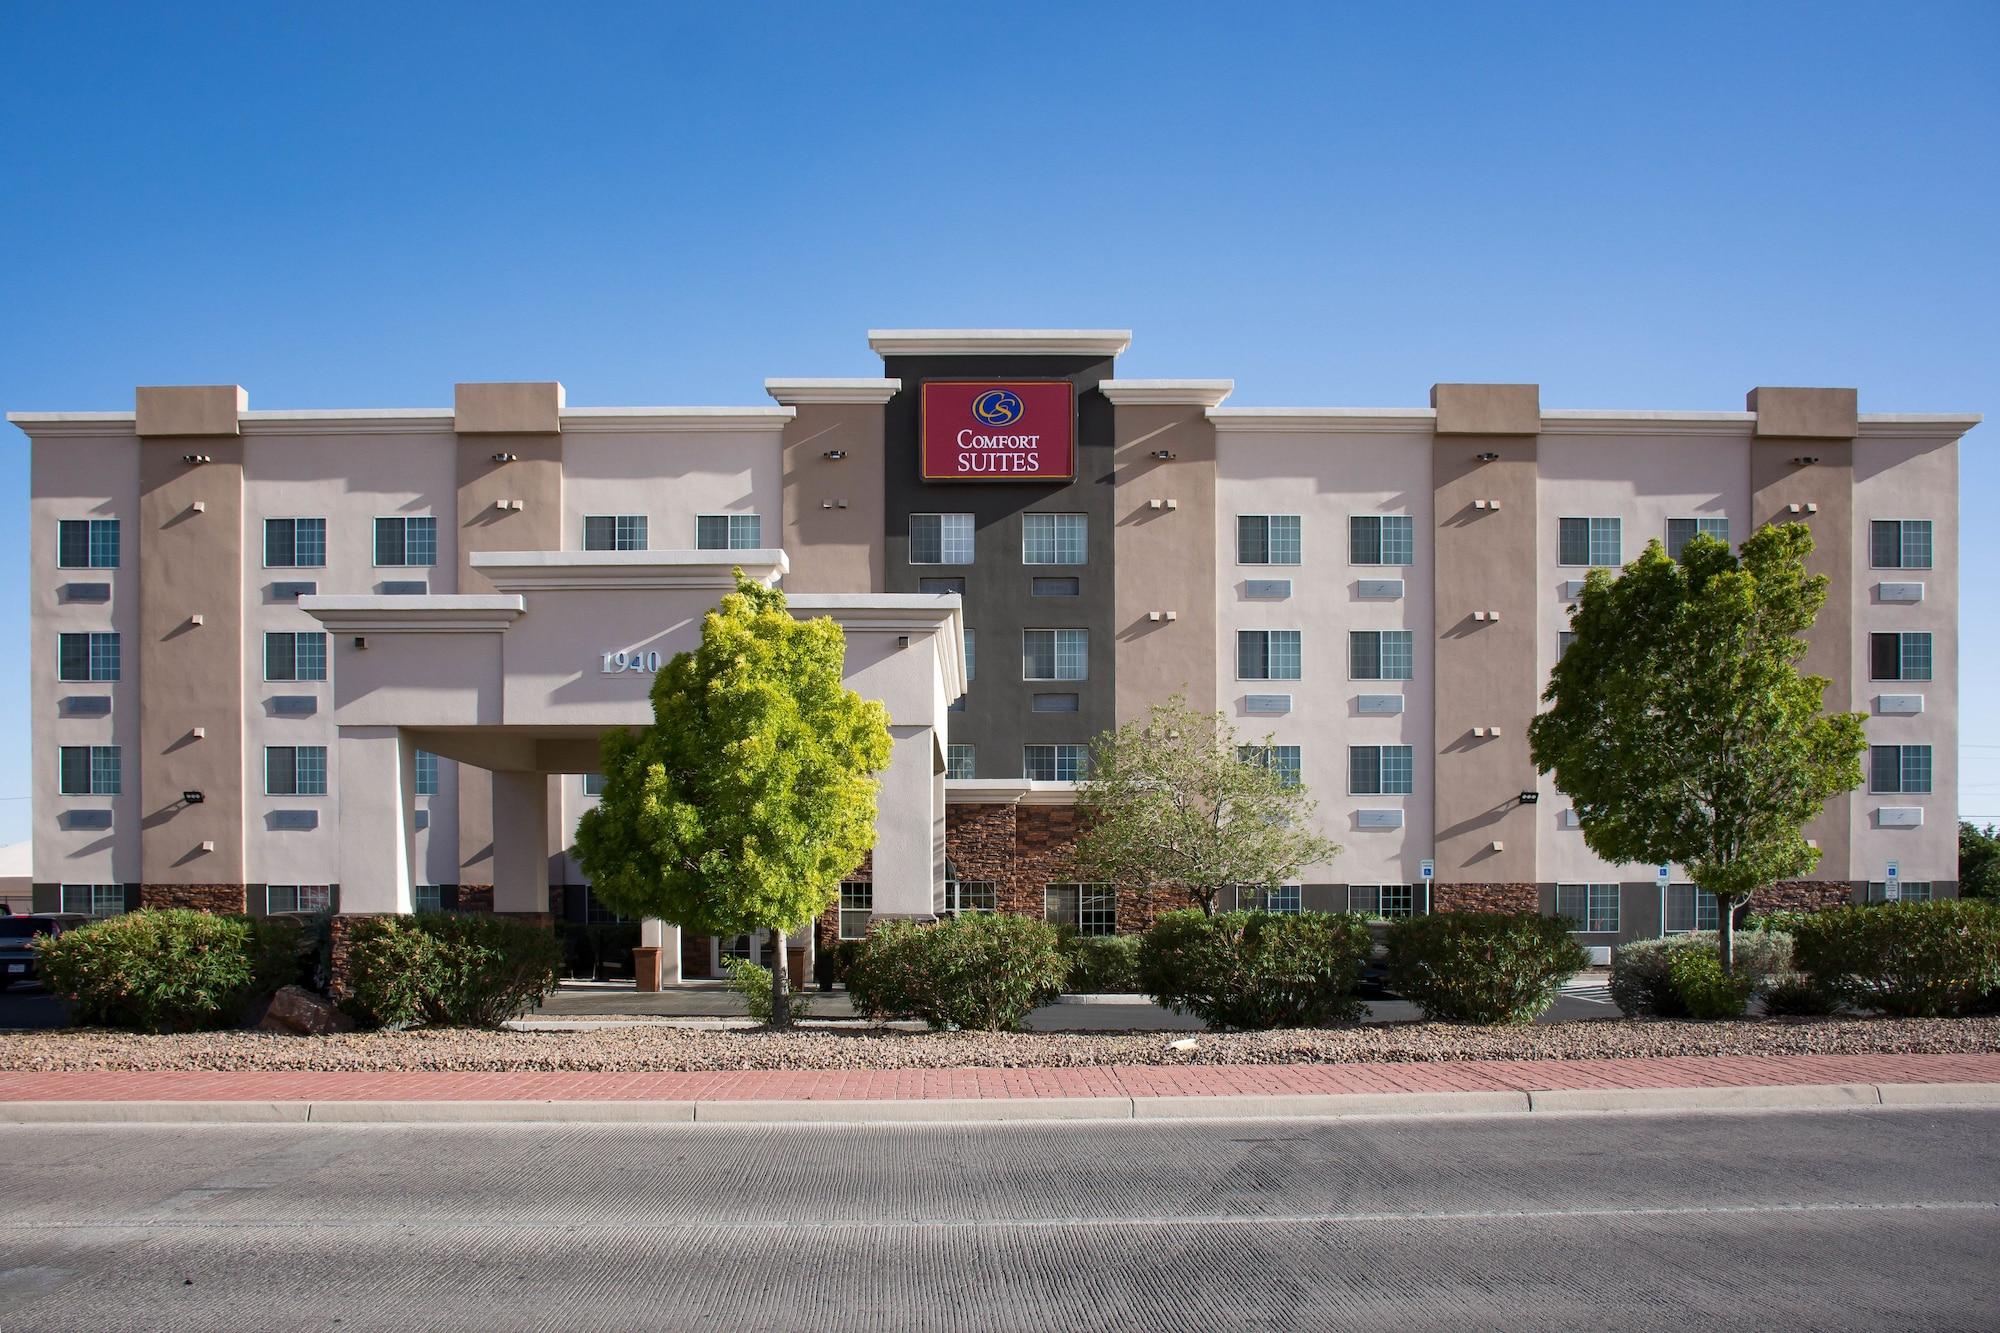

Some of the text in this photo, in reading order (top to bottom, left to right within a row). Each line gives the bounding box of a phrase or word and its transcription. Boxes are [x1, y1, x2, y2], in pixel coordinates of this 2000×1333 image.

[957, 429, 1040, 449] COMFORT
[957, 452, 1040, 472] SUITES
[600, 650, 662, 674] 1940
